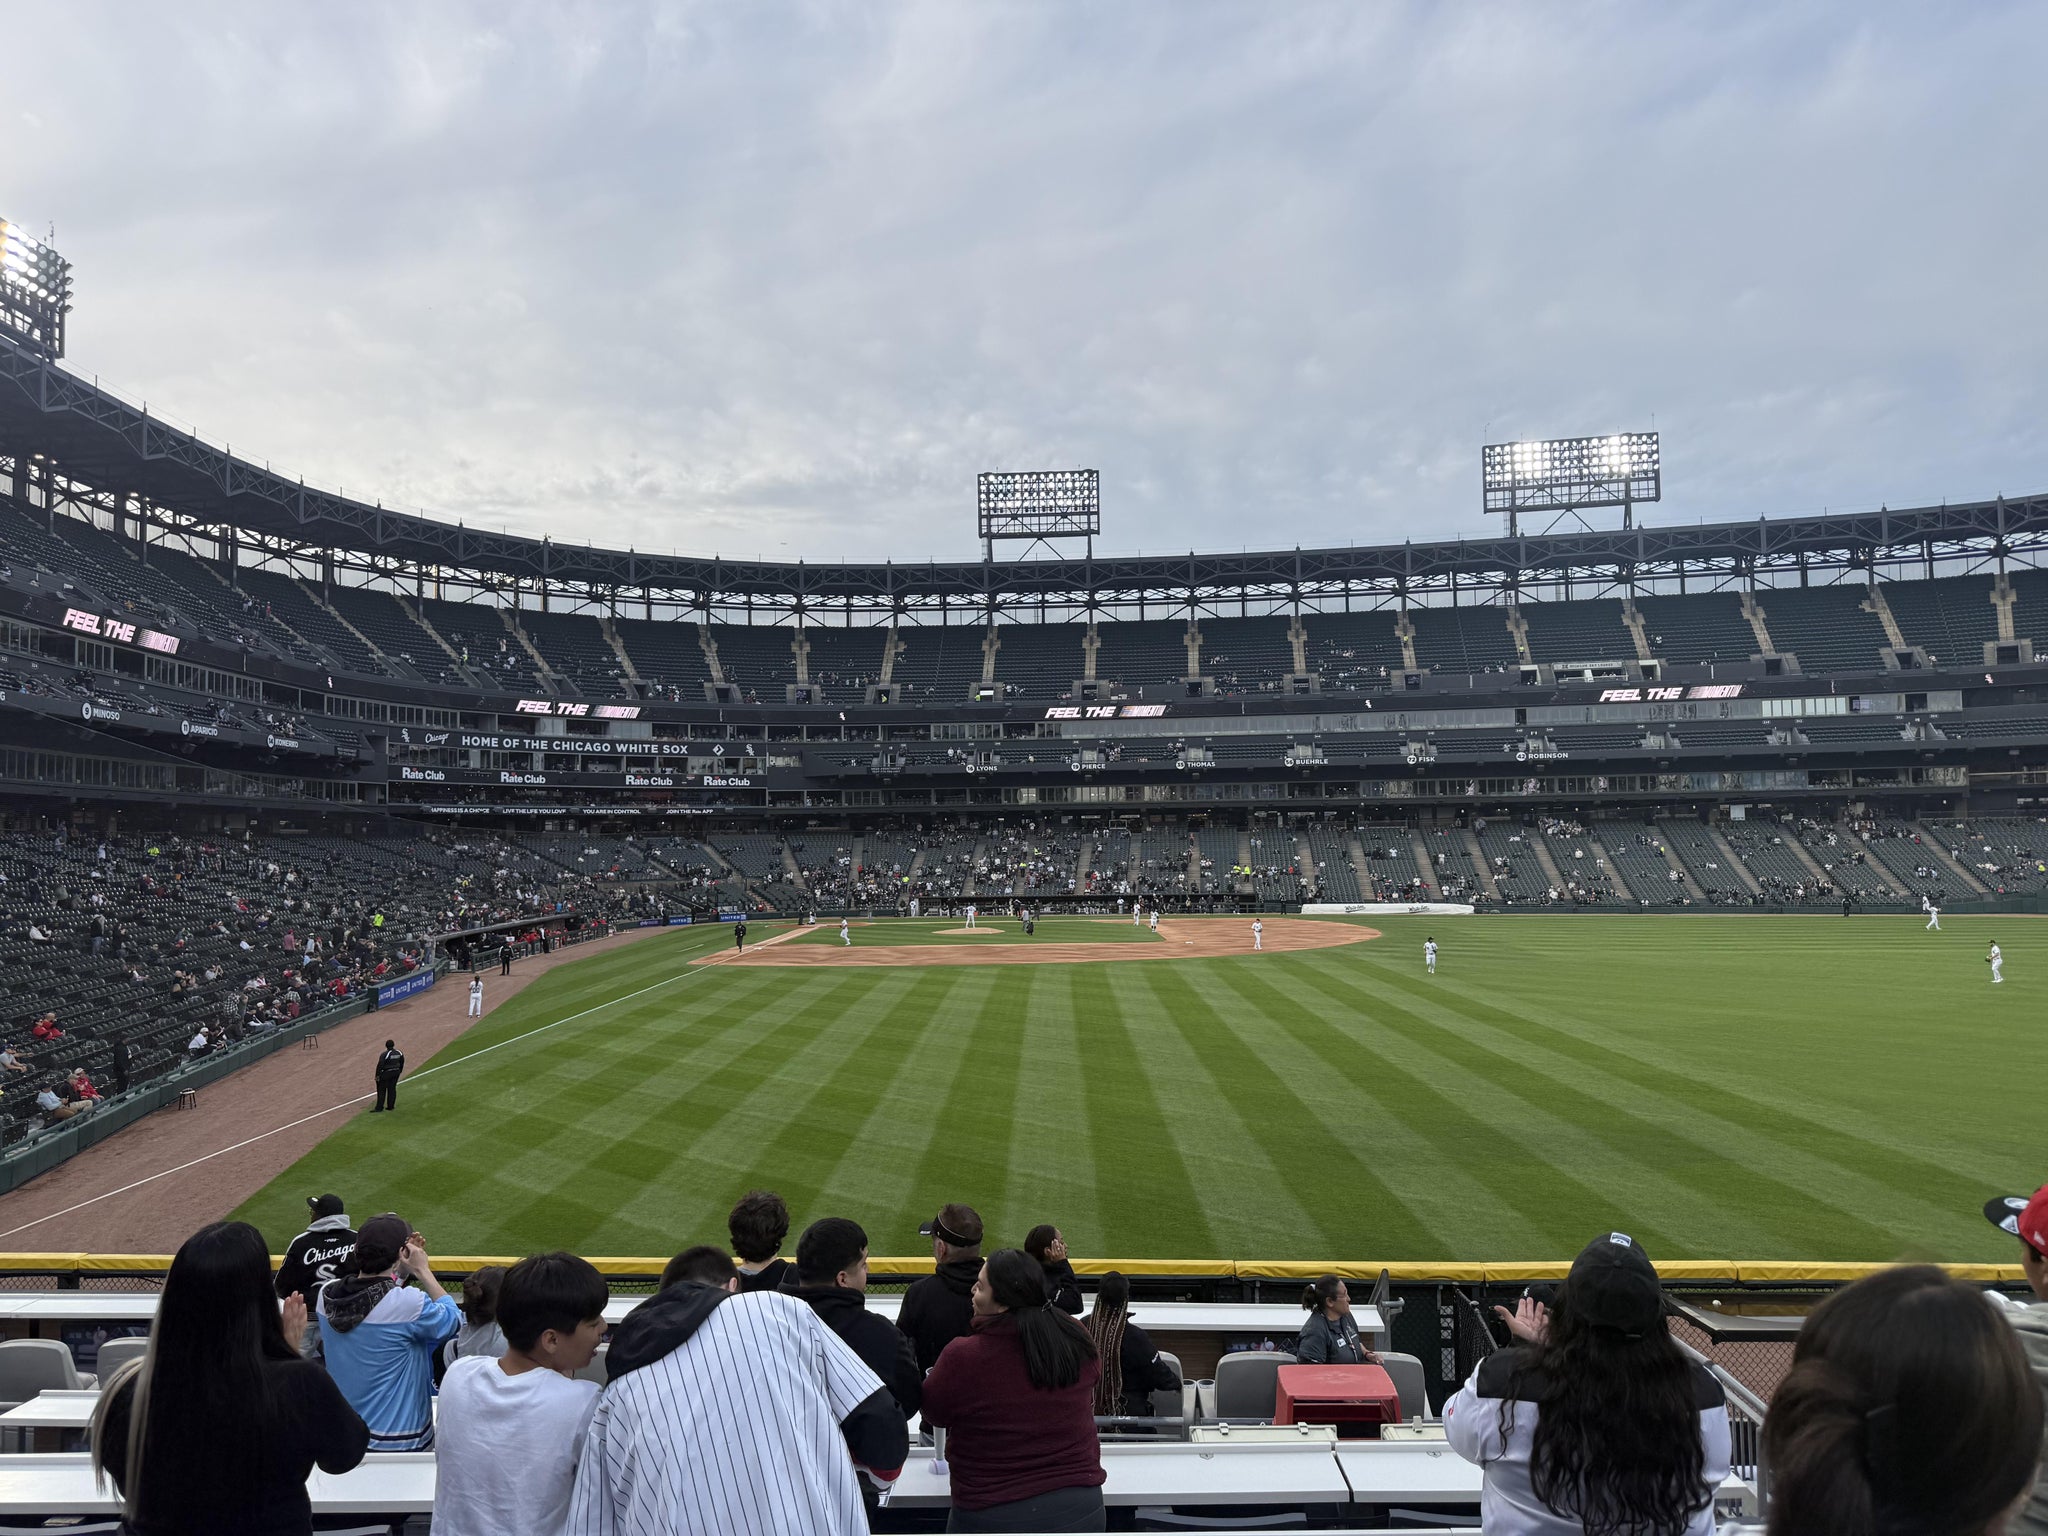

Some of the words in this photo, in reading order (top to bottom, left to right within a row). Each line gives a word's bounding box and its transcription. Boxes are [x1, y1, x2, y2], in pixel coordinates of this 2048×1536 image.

[63, 608, 101, 635] FEEL
[104, 618, 136, 643] THE
[1599, 688, 1641, 702] FEEL
[1647, 687, 1683, 700] THE
[93, 707, 121, 721] MINOSO
[515, 700, 553, 713] FEEL
[557, 703, 589, 715] THE
[1045, 707, 1081, 719] FEEL
[1085, 706, 1117, 718] THE
[190, 724, 218, 737] APARICIO
[425, 732, 450, 745] Chicago
[462, 735, 499, 748] HOME
[503, 738, 520, 749] OF
[523, 739, 548, 750] THE
[552, 740, 611, 753] CHICAGO
[616, 743, 659, 754] WHITE
[662, 744, 688, 755] SOX
[1528, 752, 1569, 760] ROBINSON
[402, 767, 424, 780] Rate
[425, 770, 445, 781] Club
[501, 772, 523, 783] Rate
[524, 773, 546, 784] Club
[625, 775, 649, 786] Rate
[650, 776, 673, 786] Club
[703, 776, 727, 786] Rate
[728, 777, 751, 786] Club
[303, 1243, 356, 1266] Chicago
